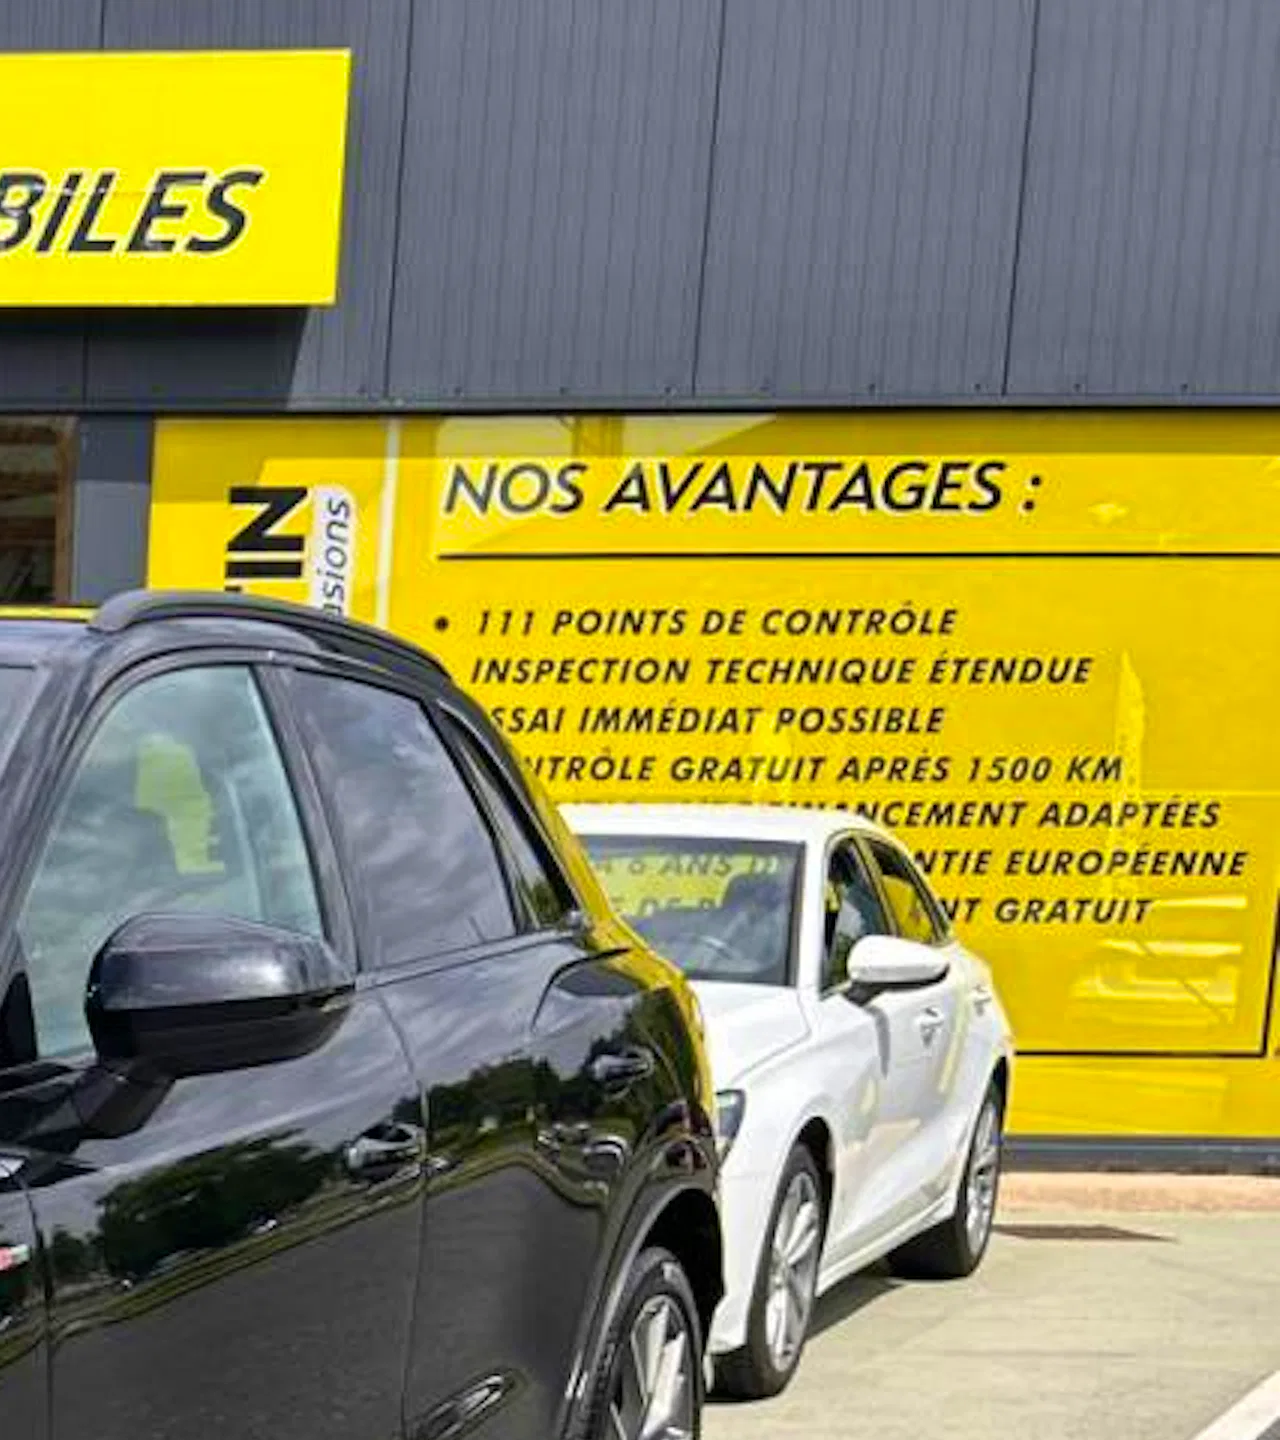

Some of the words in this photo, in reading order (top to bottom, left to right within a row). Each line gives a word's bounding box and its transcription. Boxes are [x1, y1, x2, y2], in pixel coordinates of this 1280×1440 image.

[444, 462, 588, 514] NOS
[604, 461, 1008, 513] AVANTAGES
[477, 609, 535, 636] 111
[551, 608, 688, 636] POINTS
[700, 608, 747, 636] DE
[761, 601, 959, 636] CONTRÔLE
[471, 657, 692, 685] INSPECTION
[705, 657, 917, 686] TECHNIQUE
[928, 651, 1094, 685] ÉTENDUE
[491, 706, 567, 733] SSAI
[578, 698, 763, 733] IMMÉDIAT
[774, 706, 946, 733] POSSIBLE
[669, 755, 827, 782] GRATUIT
[967, 756, 1052, 782] 1500
[1066, 756, 1124, 782] KM
[1039, 794, 1221, 828] ADAPTÉES
[1003, 844, 1249, 877] EUROPÉENNE
[994, 896, 1153, 925] GRATUIT
